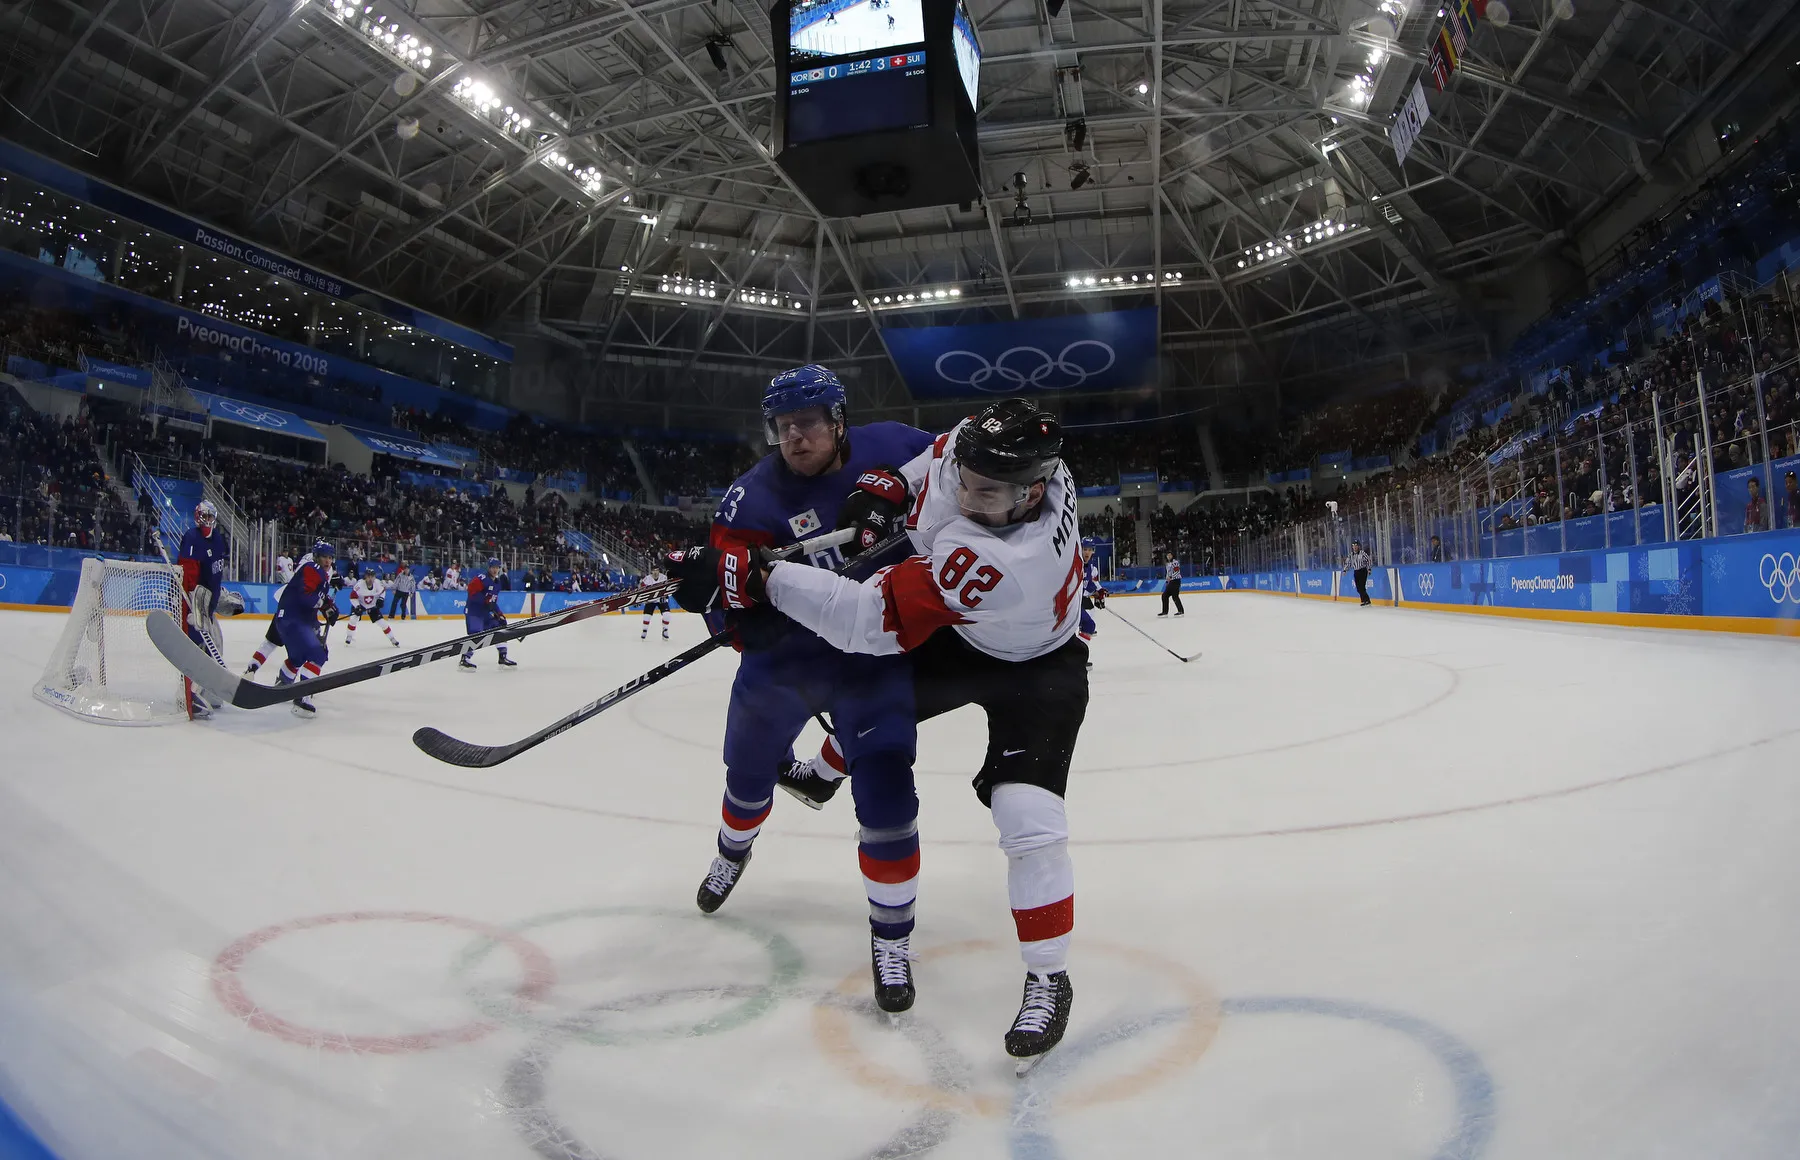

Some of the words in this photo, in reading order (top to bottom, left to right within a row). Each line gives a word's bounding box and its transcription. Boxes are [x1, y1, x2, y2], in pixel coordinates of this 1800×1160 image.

[850, 60, 871, 71] 1:42
[877, 58, 885, 70] 3
[907, 55, 920, 63] SUI
[791, 73, 808, 83] KOR
[828, 66, 838, 78] 0
[195, 228, 243, 259] Passion.
[304, 272, 326, 290] 하나된
[291, 351, 328, 376] 2018
[981, 417, 1003, 433] 82
[189, 545, 193, 556] 1
[940, 547, 1004, 608] 82
[1512, 576, 1556, 593] PyeongChang
[1556, 574, 1574, 590] 2018
[379, 633, 496, 677] CCM
